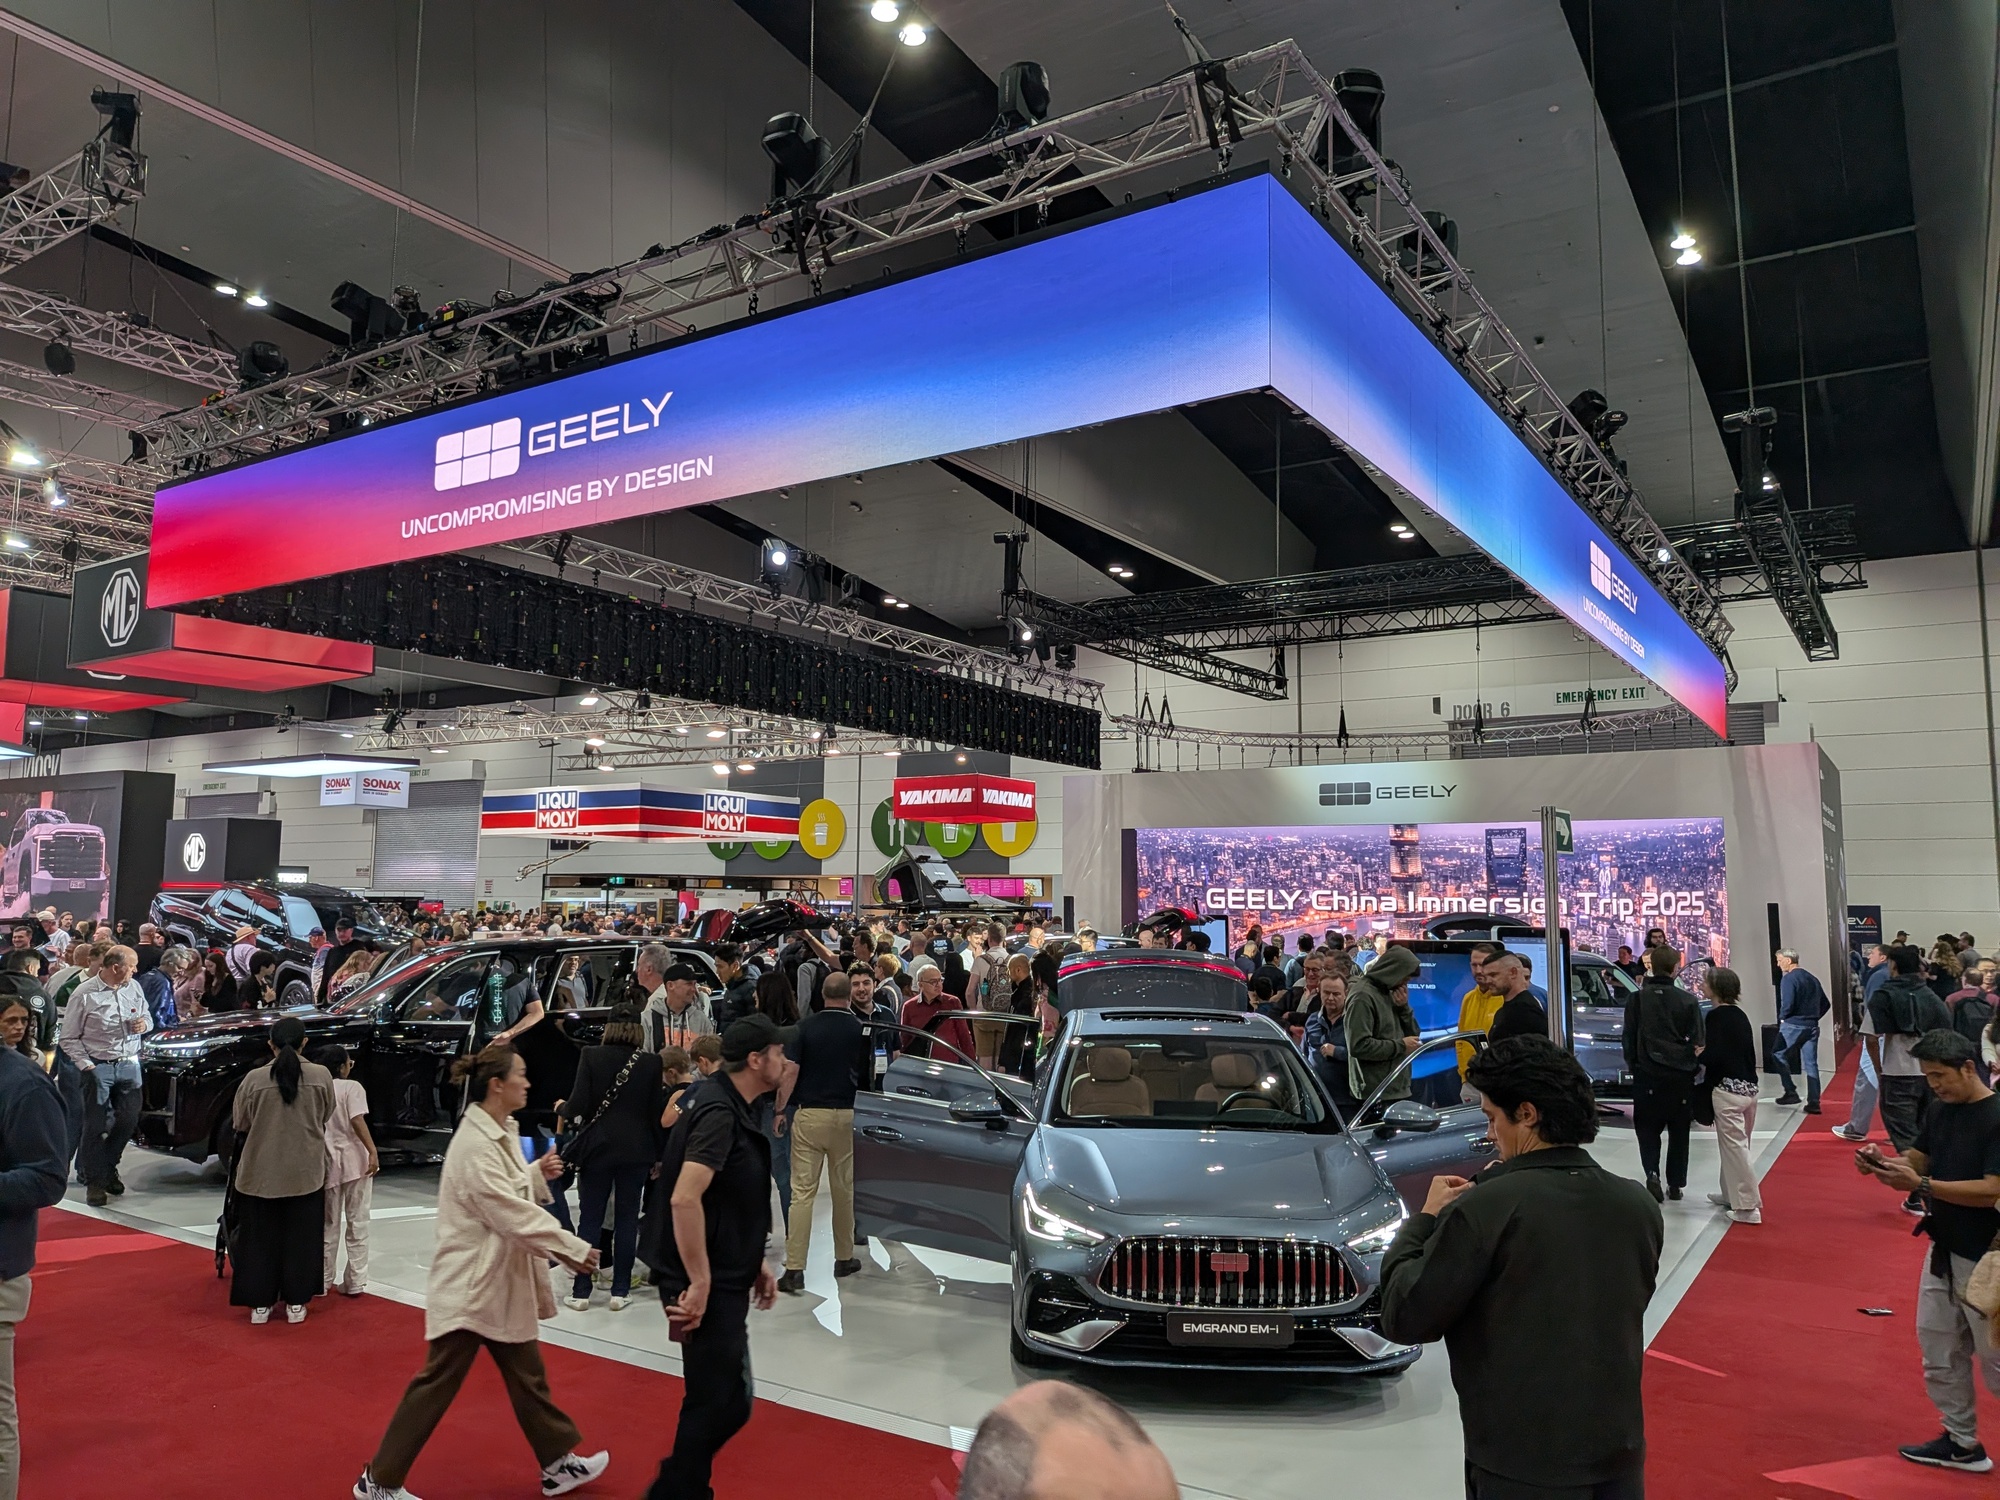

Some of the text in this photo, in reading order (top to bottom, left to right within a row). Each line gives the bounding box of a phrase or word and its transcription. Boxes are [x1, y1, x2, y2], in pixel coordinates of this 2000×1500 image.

[528, 391, 674, 457] GEELY
[401, 455, 714, 539] UNCOMPROMISING BY DESIGN
[1611, 572, 1638, 615] GEELY
[104, 574, 138, 641] MG
[1622, 686, 1646, 700] EXIT
[1501, 701, 1511, 718] 6
[325, 778, 351, 789] SONAX
[363, 777, 401, 790] SONAX
[1376, 784, 1458, 800] GEELY
[539, 791, 576, 809] LIQUI
[706, 795, 744, 814] LIQUI
[899, 787, 972, 806] YAKIMA
[982, 788, 1033, 808] YAKIMA
[538, 810, 576, 828] MOLY
[705, 813, 745, 831] MOLY
[185, 836, 205, 869] MG
[1206, 888, 1303, 911] GEELY
[1311, 889, 1398, 913] China
[1576, 891, 1634, 918] Trip
[1640, 890, 1706, 916] 2025
[1182, 1323, 1279, 1334] EMGRAND EM-i
